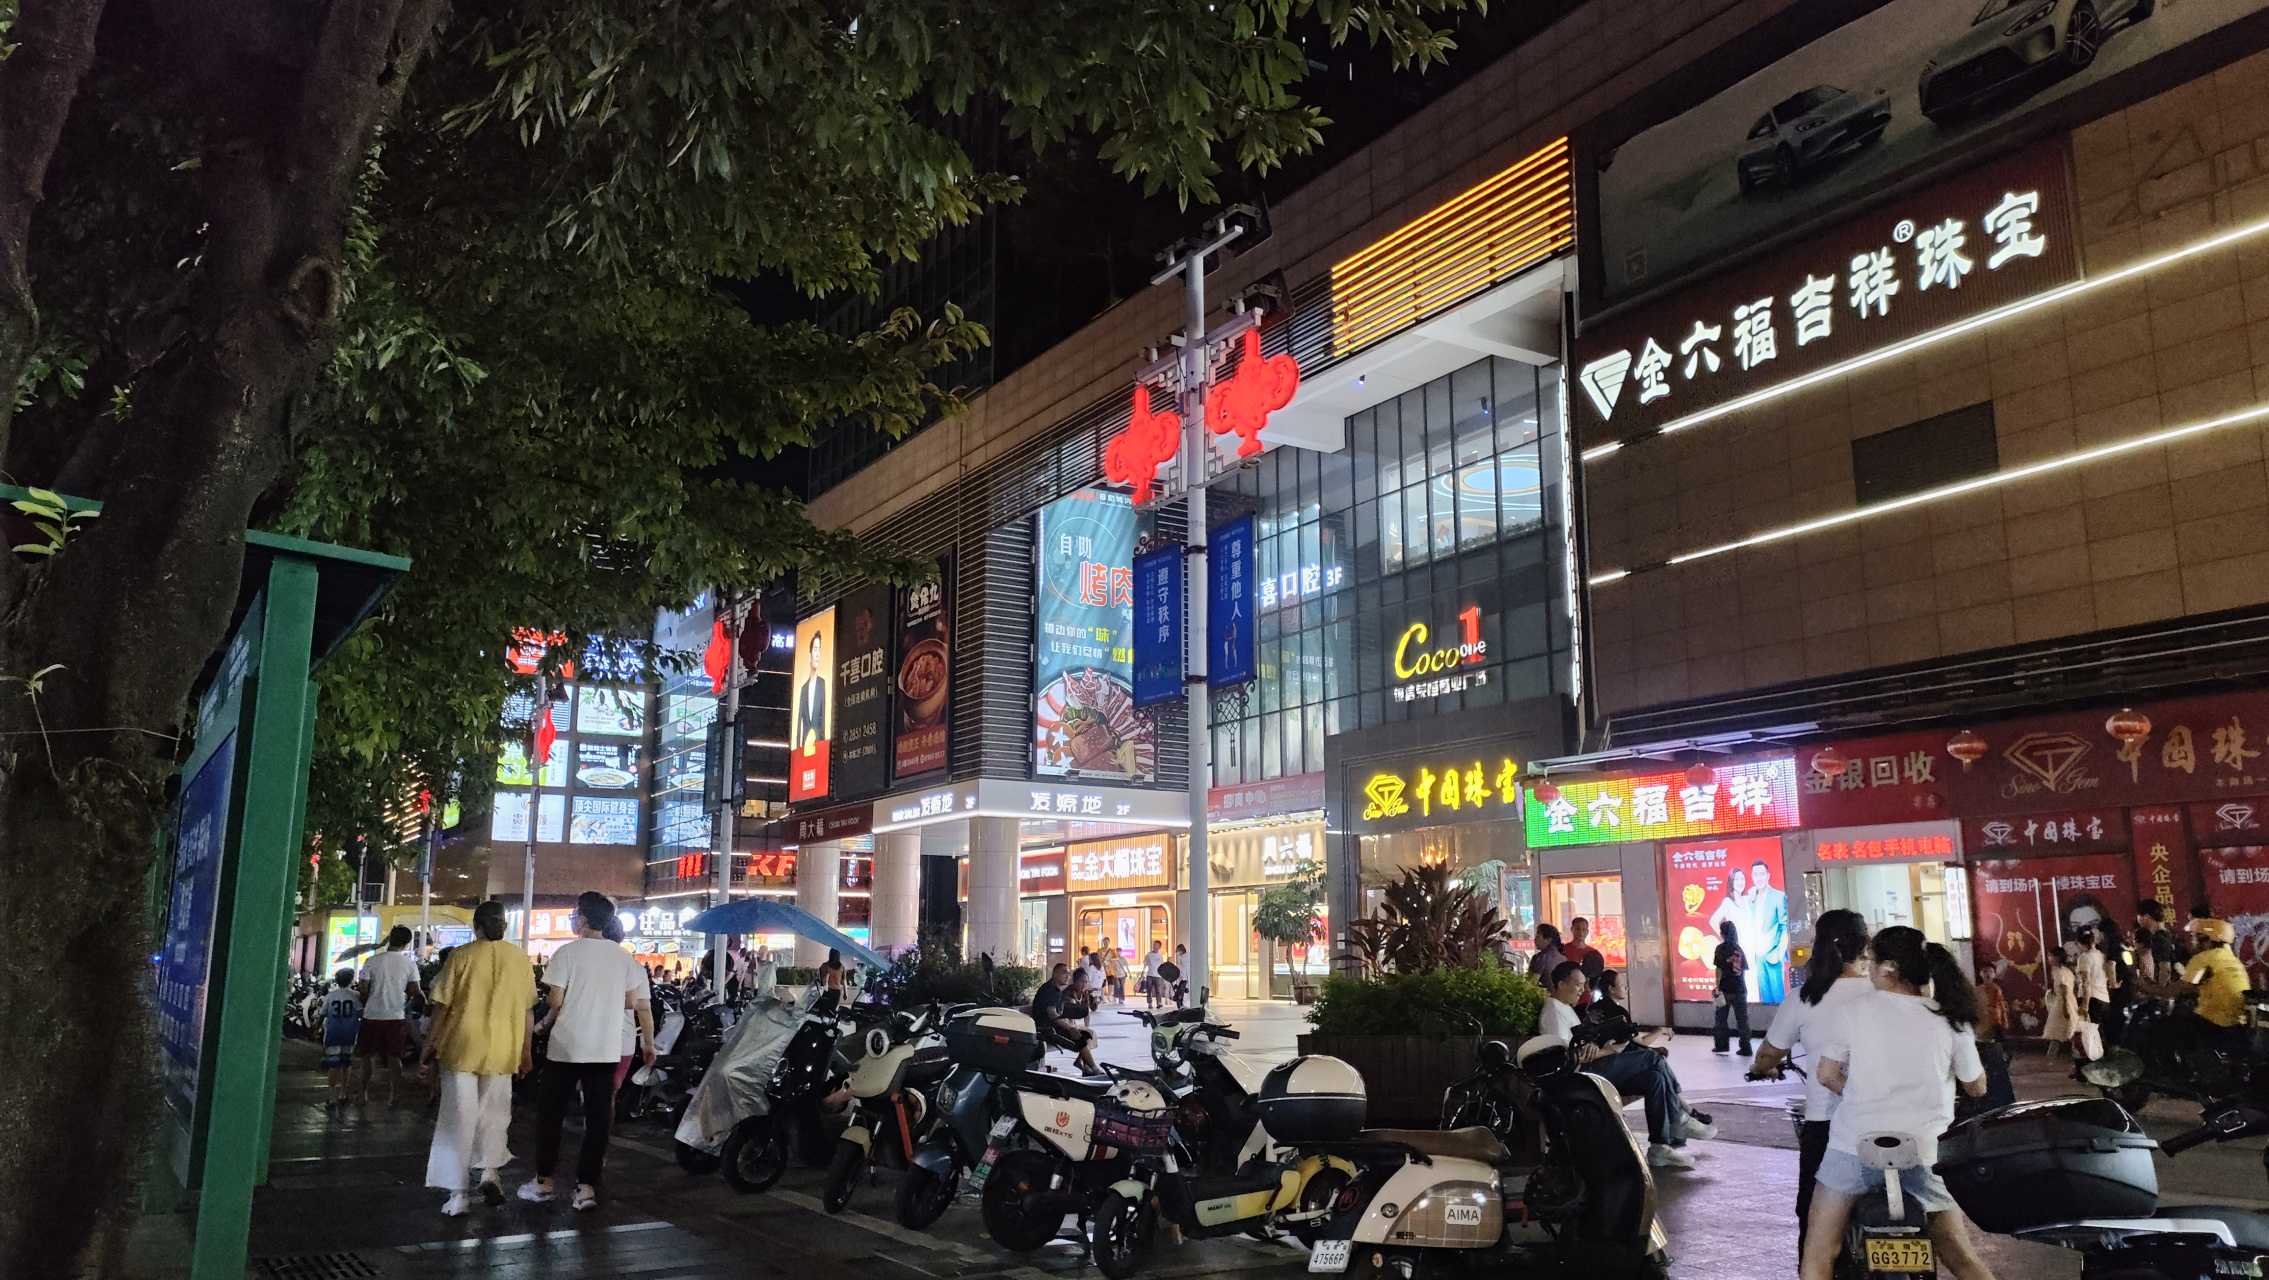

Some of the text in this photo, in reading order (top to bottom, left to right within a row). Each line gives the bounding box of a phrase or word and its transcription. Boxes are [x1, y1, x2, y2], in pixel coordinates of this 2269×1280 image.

[1633, 190, 2046, 404] 金六福吉祥珠宝
[1060, 534, 1092, 557] 自助
[1080, 562, 1132, 607] 烤肉
[1230, 539, 1243, 621] 尊重他人
[1326, 566, 1342, 587] 3F
[1157, 566, 1171, 644] 遵守秩序
[1395, 623, 1459, 679] Coco
[840, 647, 884, 686] 千喜口腔
[1416, 759, 1518, 816] 中国珠宝
[1030, 791, 1130, 817] 发源地 2F
[799, 818, 824, 840] 周大福
[2023, 817, 2104, 846] 中国珠宝
[677, 852, 703, 879] 肯德基
[332, 999, 354, 1016] 30
[1447, 1208, 1480, 1222] AIMA
[1313, 1253, 1345, 1265] 47566P
[1871, 1251, 1930, 1265] GG3772
